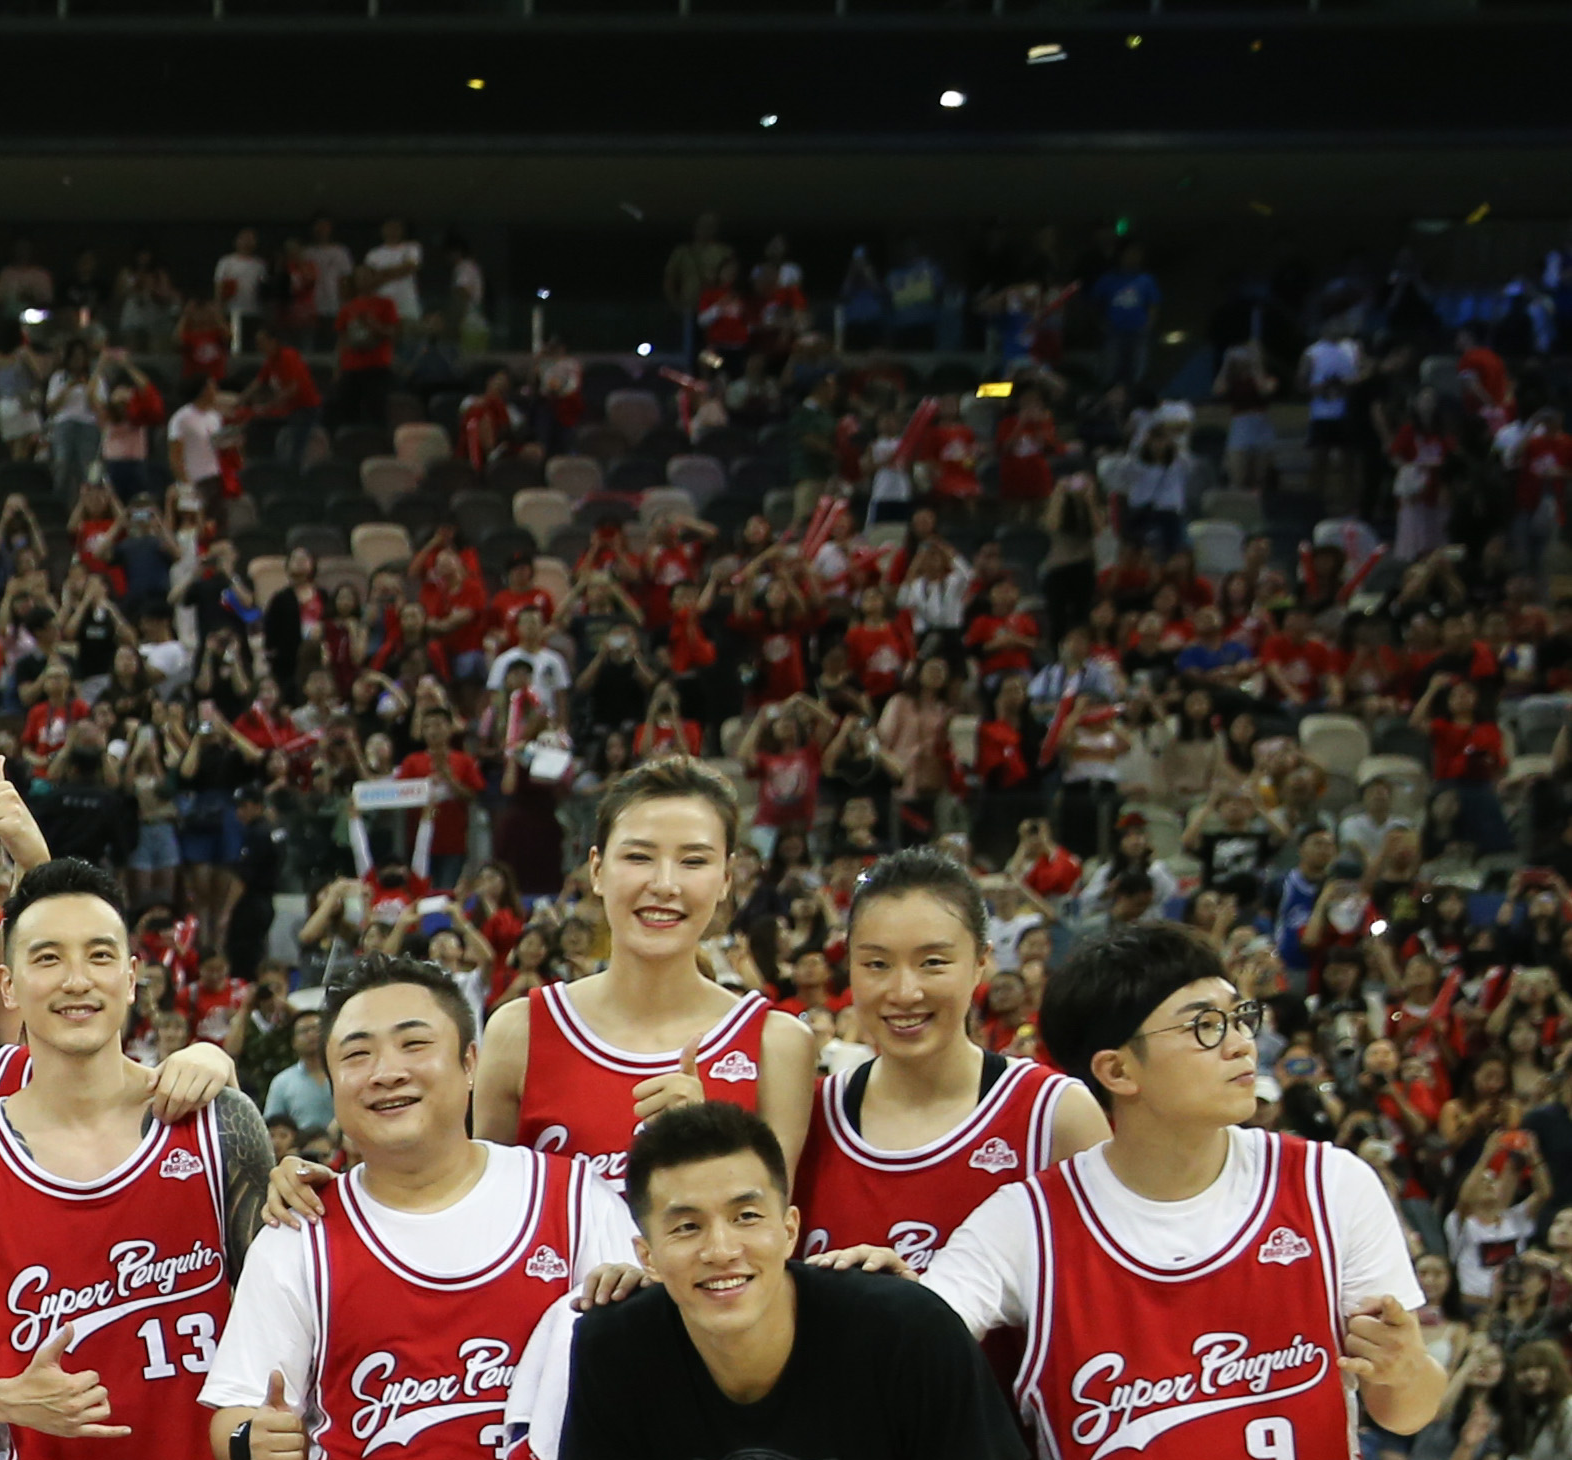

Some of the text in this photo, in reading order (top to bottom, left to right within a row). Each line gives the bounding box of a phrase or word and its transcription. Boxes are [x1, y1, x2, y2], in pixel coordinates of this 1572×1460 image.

[6, 1240, 224, 1353] Super Penguin
[136, 1312, 217, 1381] 13
[350, 1350, 461, 1441] Super
[1071, 1332, 1330, 1446] Super Penguin
